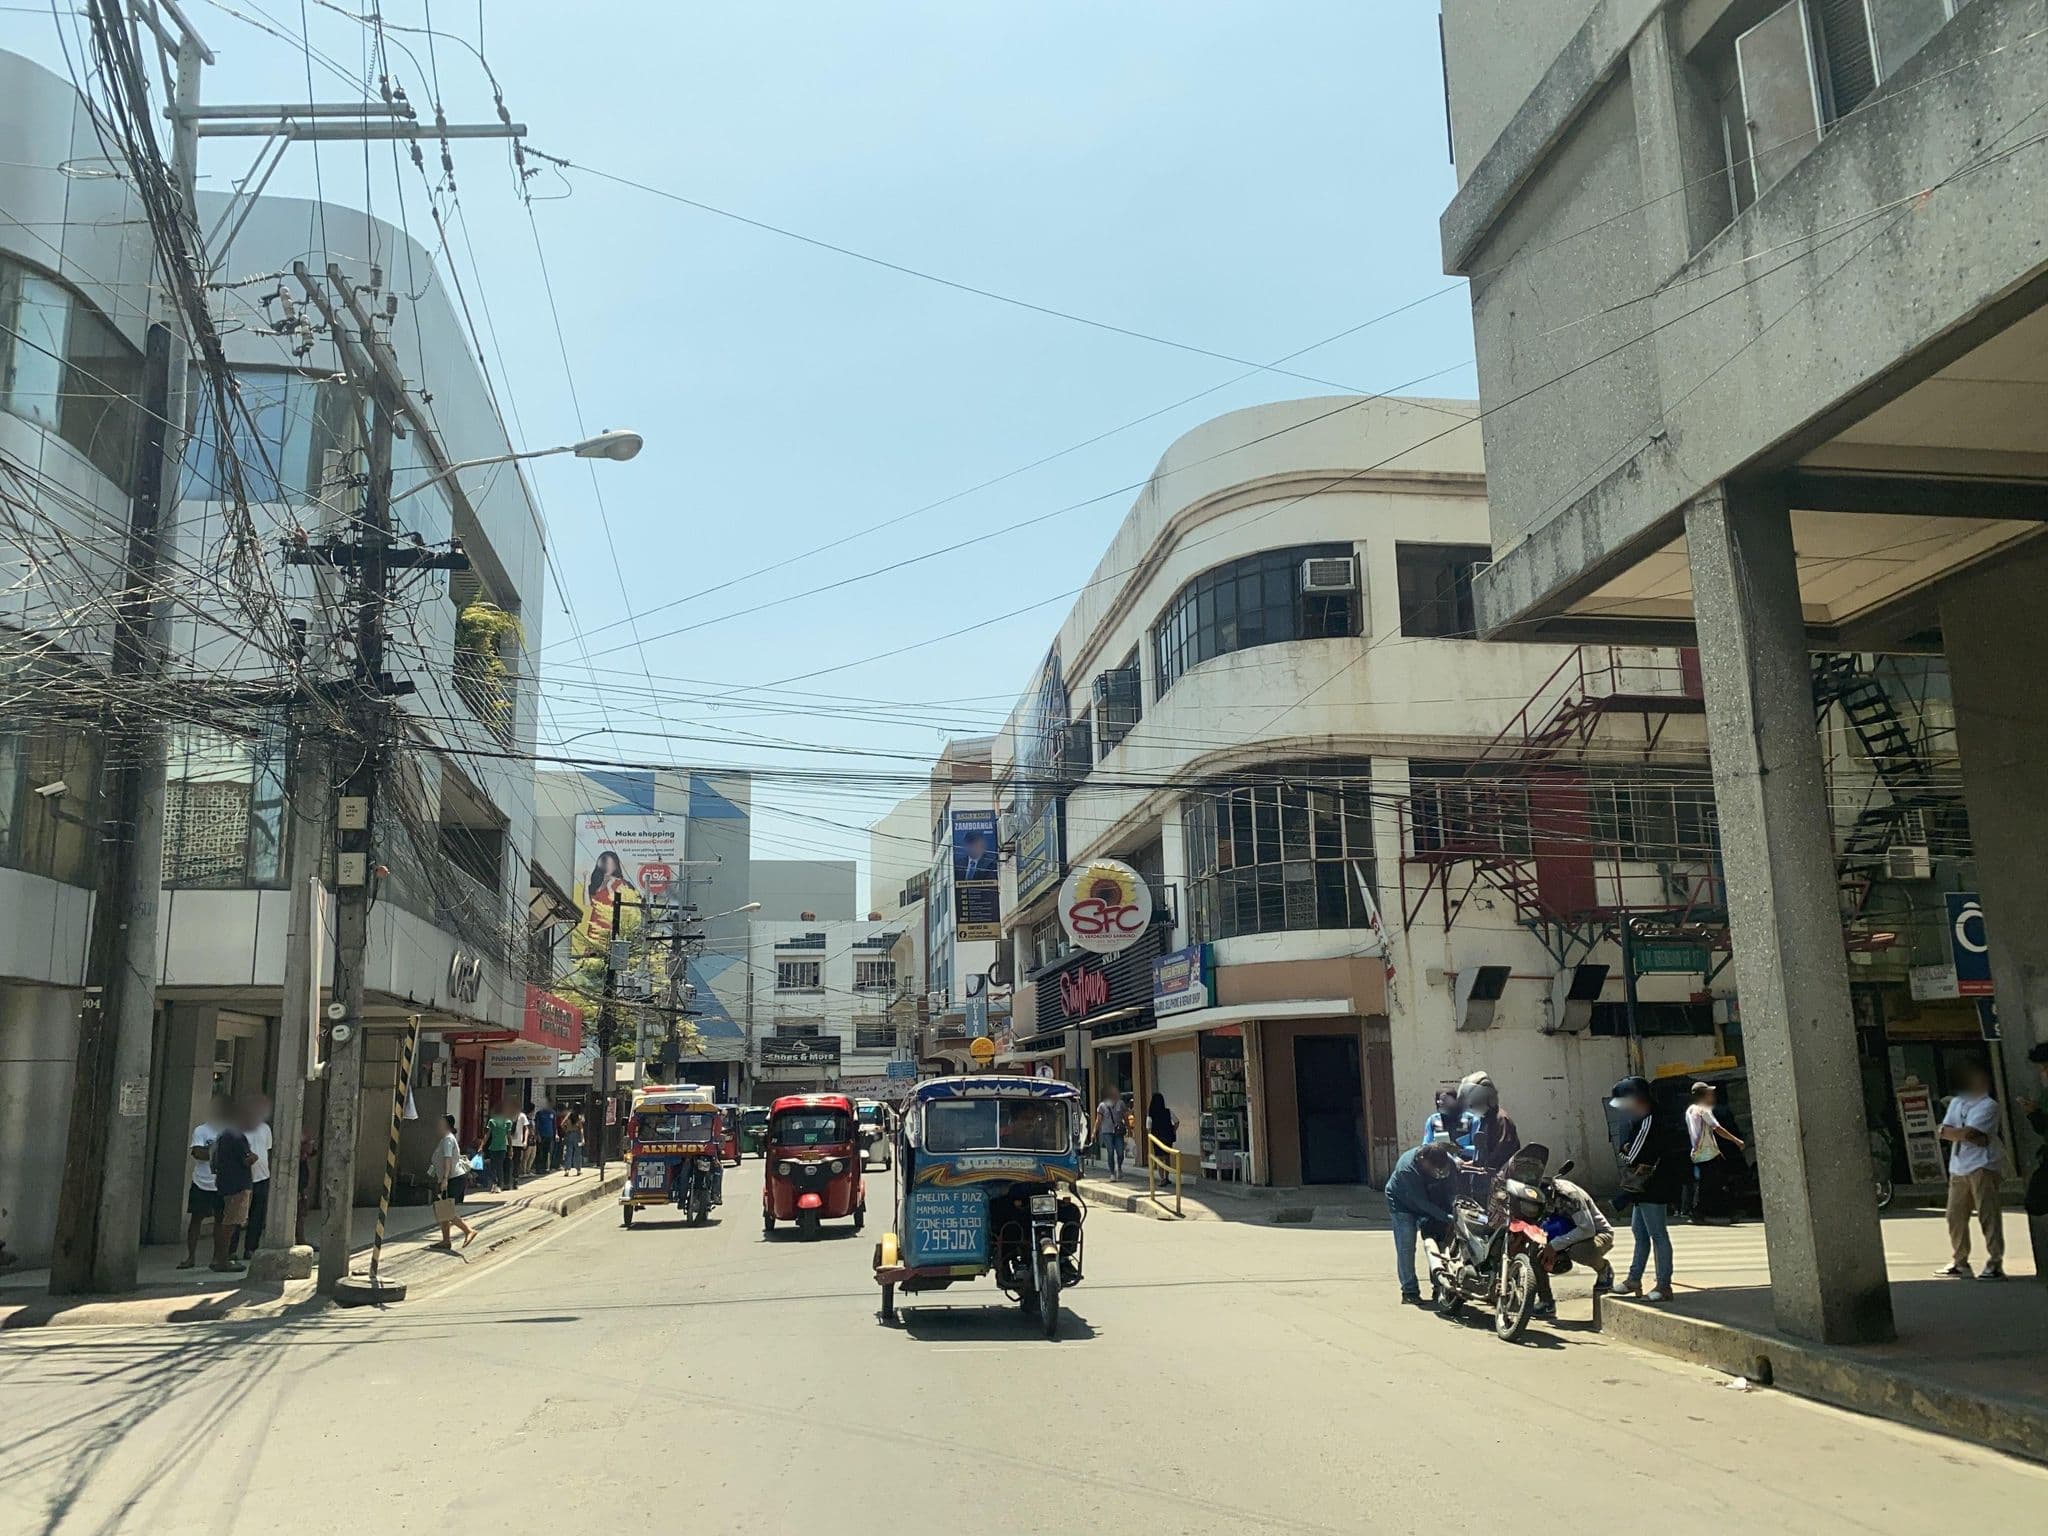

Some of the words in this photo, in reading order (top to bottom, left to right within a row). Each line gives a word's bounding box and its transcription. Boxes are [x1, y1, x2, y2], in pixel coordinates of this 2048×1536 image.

[954, 821, 993, 831] ZAMBOANGA
[638, 830, 675, 838] shopping
[1068, 899, 1145, 934] SFC
[1060, 966, 1109, 1017] Sunflower
[916, 1192, 950, 1203] EMELITA
[961, 1192, 982, 1202] DIAZ
[916, 1205, 955, 1215] MAMPANG
[921, 1229, 977, 1252] 299JQX
